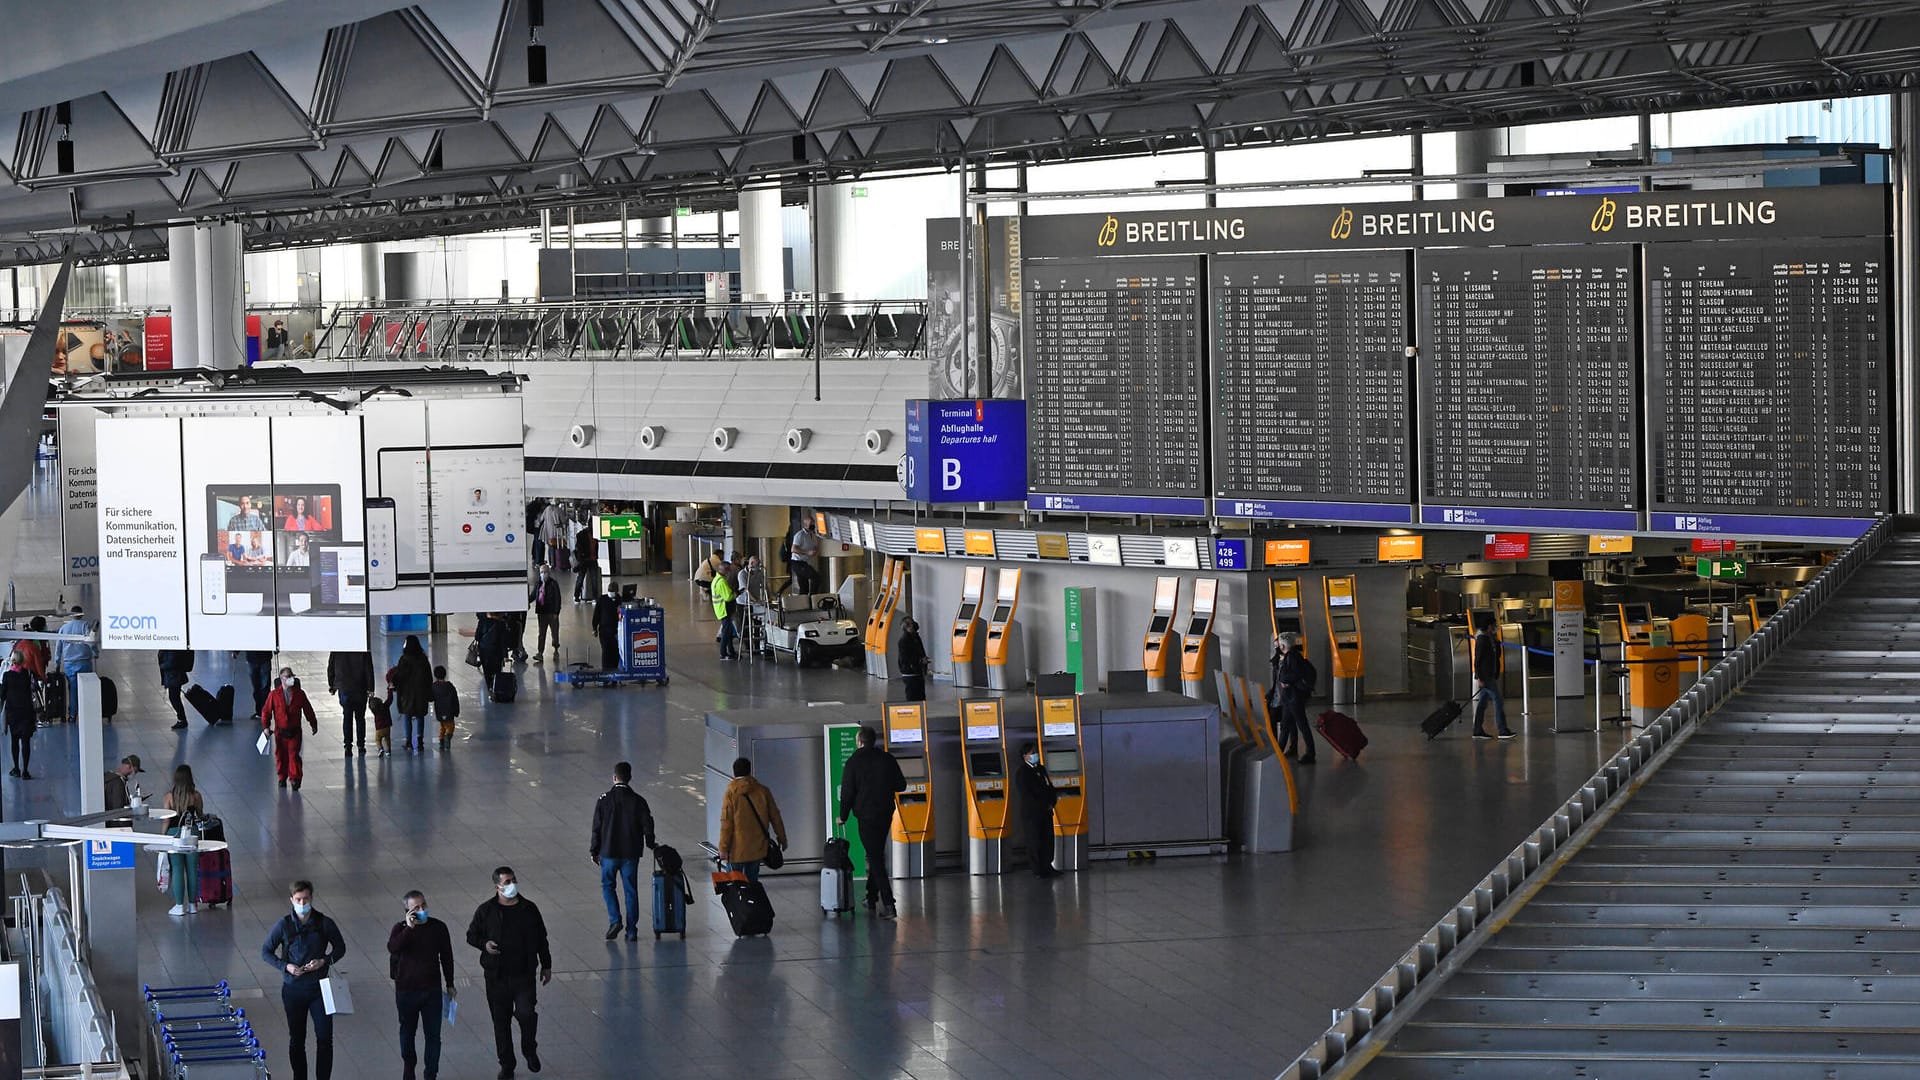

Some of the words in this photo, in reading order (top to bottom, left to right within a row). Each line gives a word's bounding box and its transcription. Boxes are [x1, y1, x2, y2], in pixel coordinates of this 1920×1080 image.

[1627, 200, 1776, 229] BREITLING
[1362, 210, 1495, 236] BREITLING
[1126, 218, 1244, 242] BREITLING
[941, 424, 984, 434] Abflughalle
[941, 436, 981, 445] Departures
[942, 458, 961, 490] B
[106, 507, 119, 516] Für
[122, 508, 152, 516] sichere
[106, 521, 177, 531] Kommunikation,
[106, 534, 175, 544] Datensicherheit
[107, 549, 123, 558] und
[124, 549, 177, 559] Transparenz
[1218, 548, 1237, 556] 428-
[72, 557, 99, 568] zoo
[1219, 558, 1233, 566] 499
[109, 616, 157, 629] zoom
